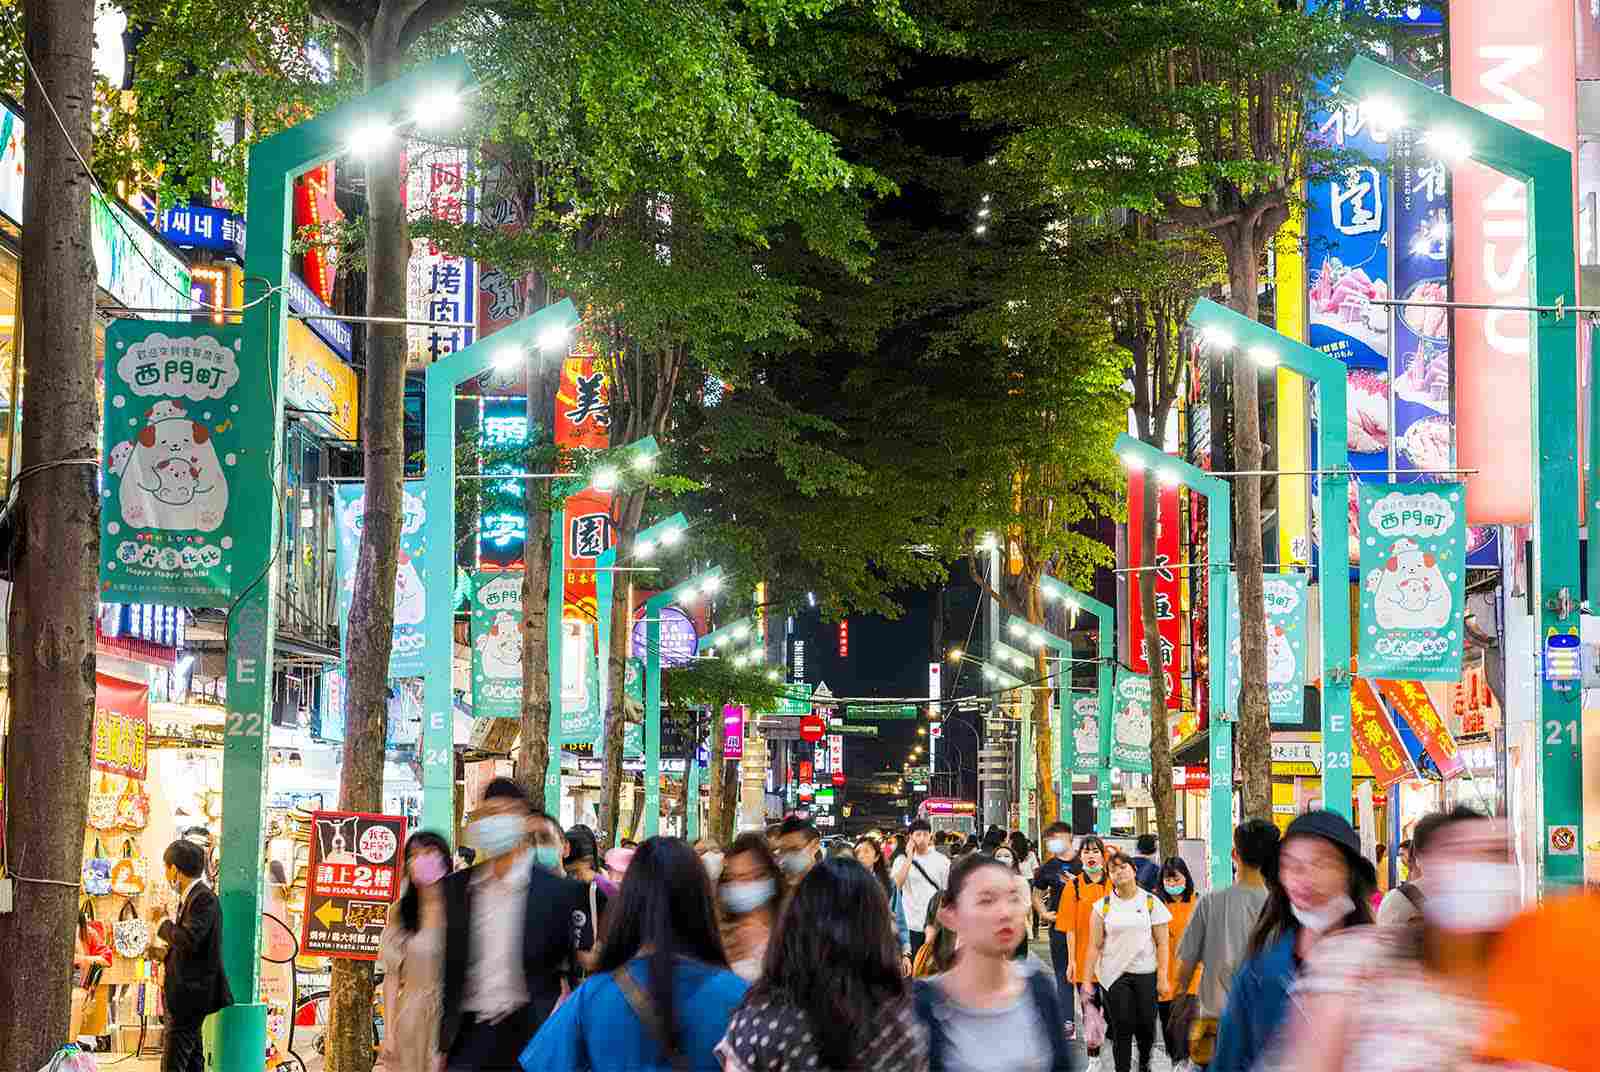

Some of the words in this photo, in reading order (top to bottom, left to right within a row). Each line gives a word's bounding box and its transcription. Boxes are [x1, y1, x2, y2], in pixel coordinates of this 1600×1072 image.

[135, 361, 228, 389] 西門町
[1381, 510, 1446, 529] 西門町
[486, 590, 522, 605] 西門
[236, 659, 257, 684] E
[228, 711, 262, 737] 22
[431, 711, 445, 729] E
[1330, 714, 1345, 733] E
[1543, 719, 1579, 745] 21
[1215, 744, 1227, 760] E
[1326, 751, 1350, 769] 23
[317, 865, 392, 888] 請上2樓
